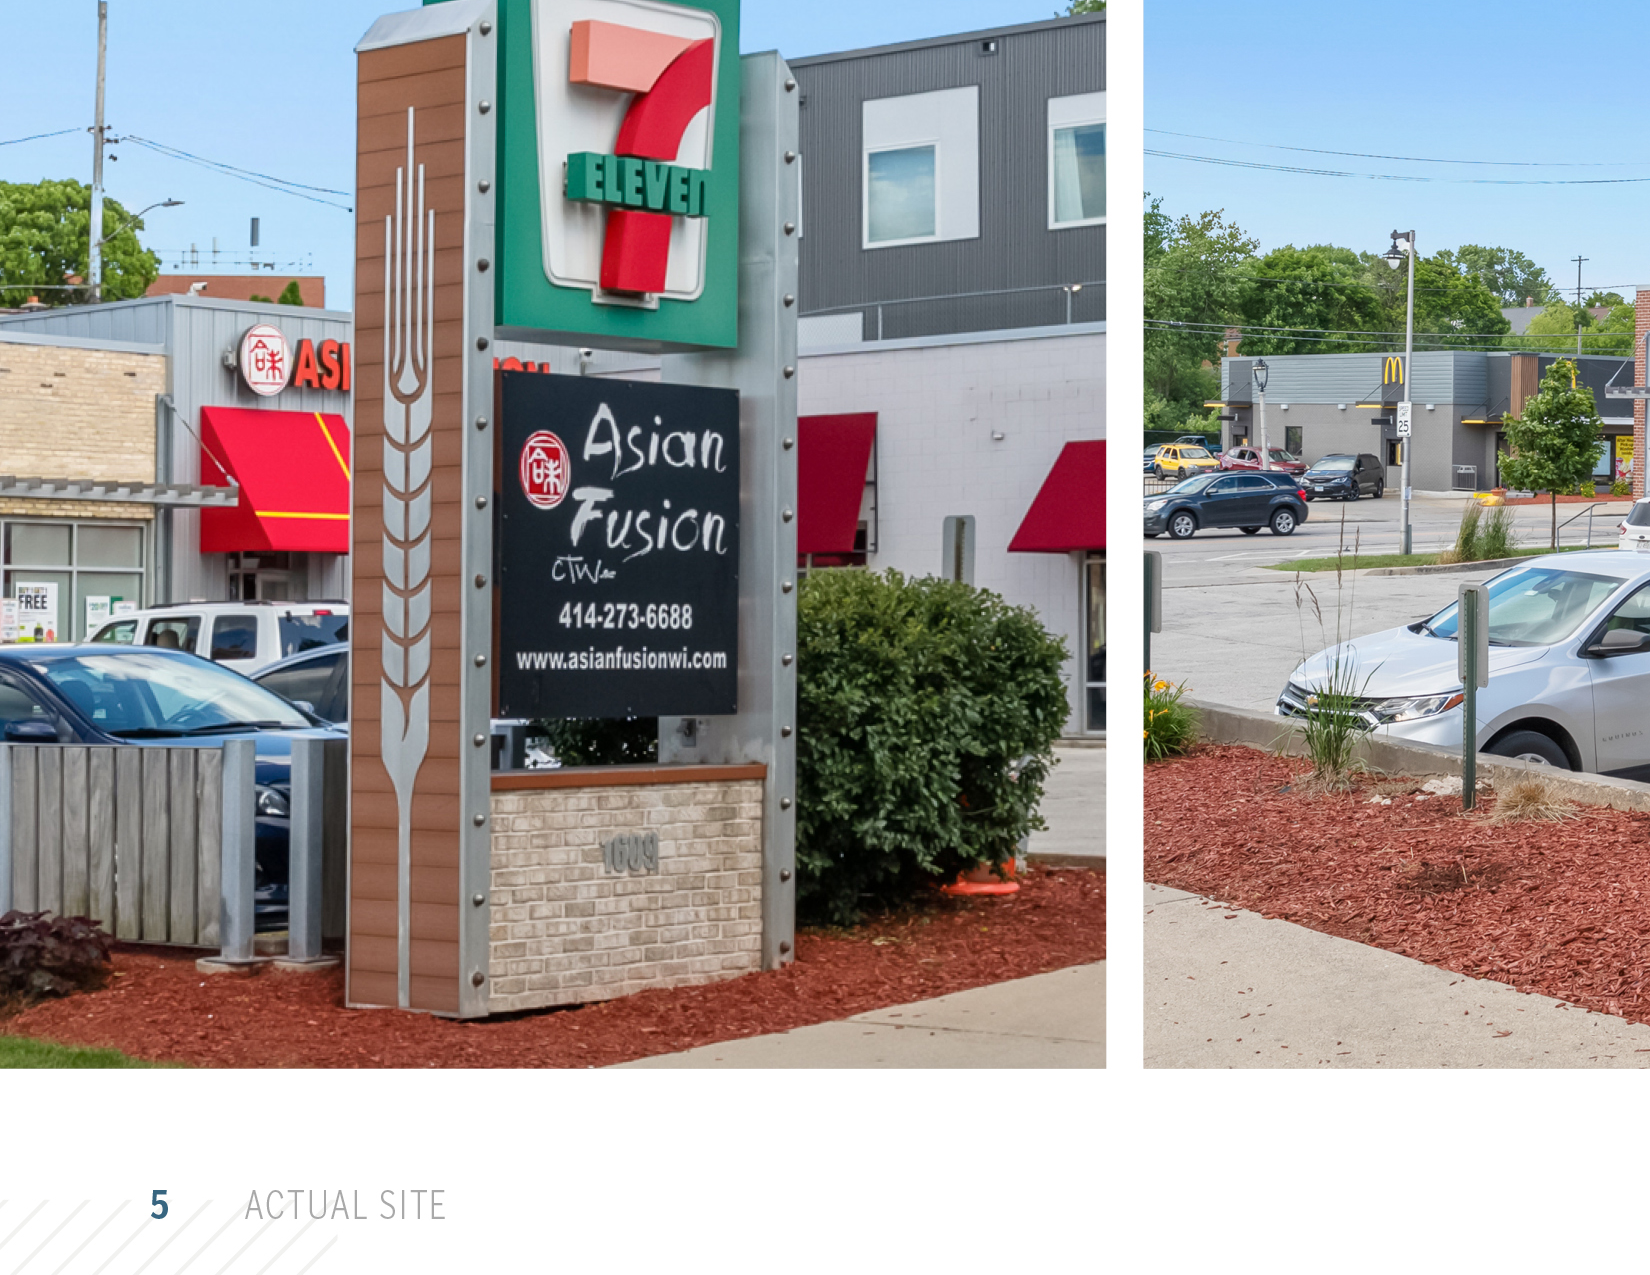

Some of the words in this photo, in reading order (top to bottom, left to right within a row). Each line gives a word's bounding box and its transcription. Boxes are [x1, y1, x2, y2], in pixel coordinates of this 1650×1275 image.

[570, 19, 714, 293] 7
[1399, 421, 1409, 432] 25
[583, 403, 727, 481] Asian
[570, 486, 727, 563] Fusion
[19, 595, 47, 609] FREE
[559, 602, 692, 629] 414-273-6688
[517, 646, 727, 669] www.asianfusionwi.com
